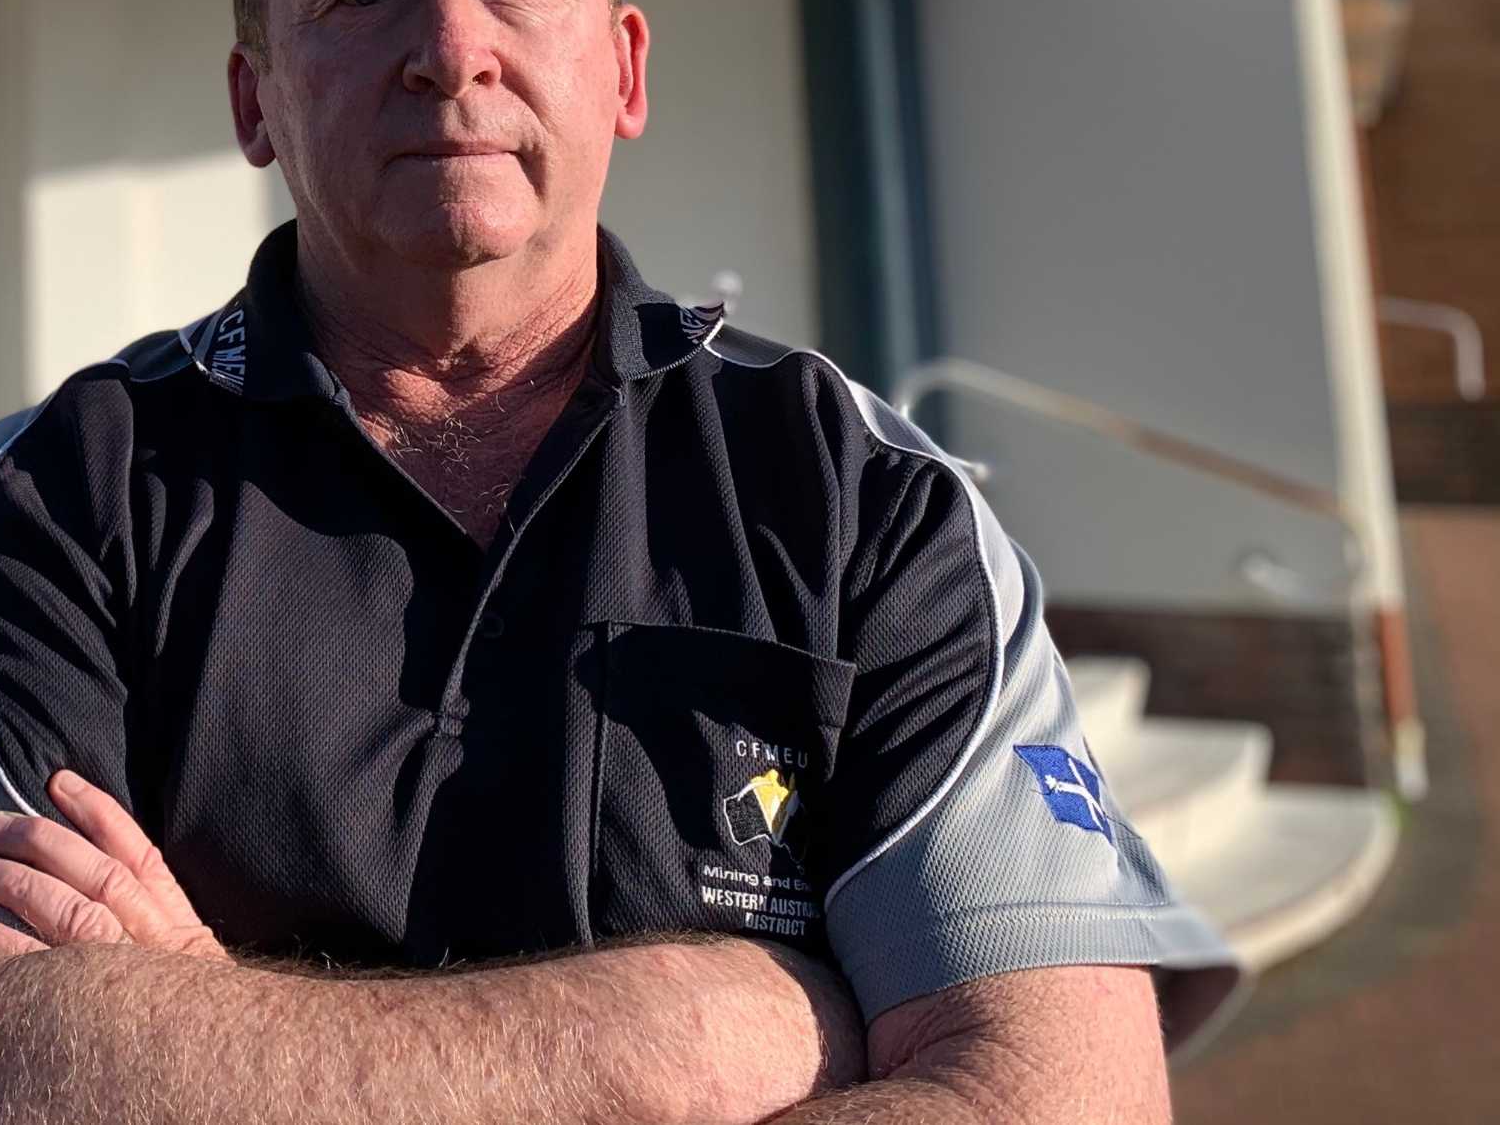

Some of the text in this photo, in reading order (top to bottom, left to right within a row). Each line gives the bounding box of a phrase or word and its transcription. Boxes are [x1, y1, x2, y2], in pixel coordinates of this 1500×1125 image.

[736, 740, 808, 768] CFMEU
[703, 864, 759, 887] Mining
[763, 874, 790, 889] and
[702, 885, 767, 911] WESTERN
[745, 912, 806, 936] DISTRICT
